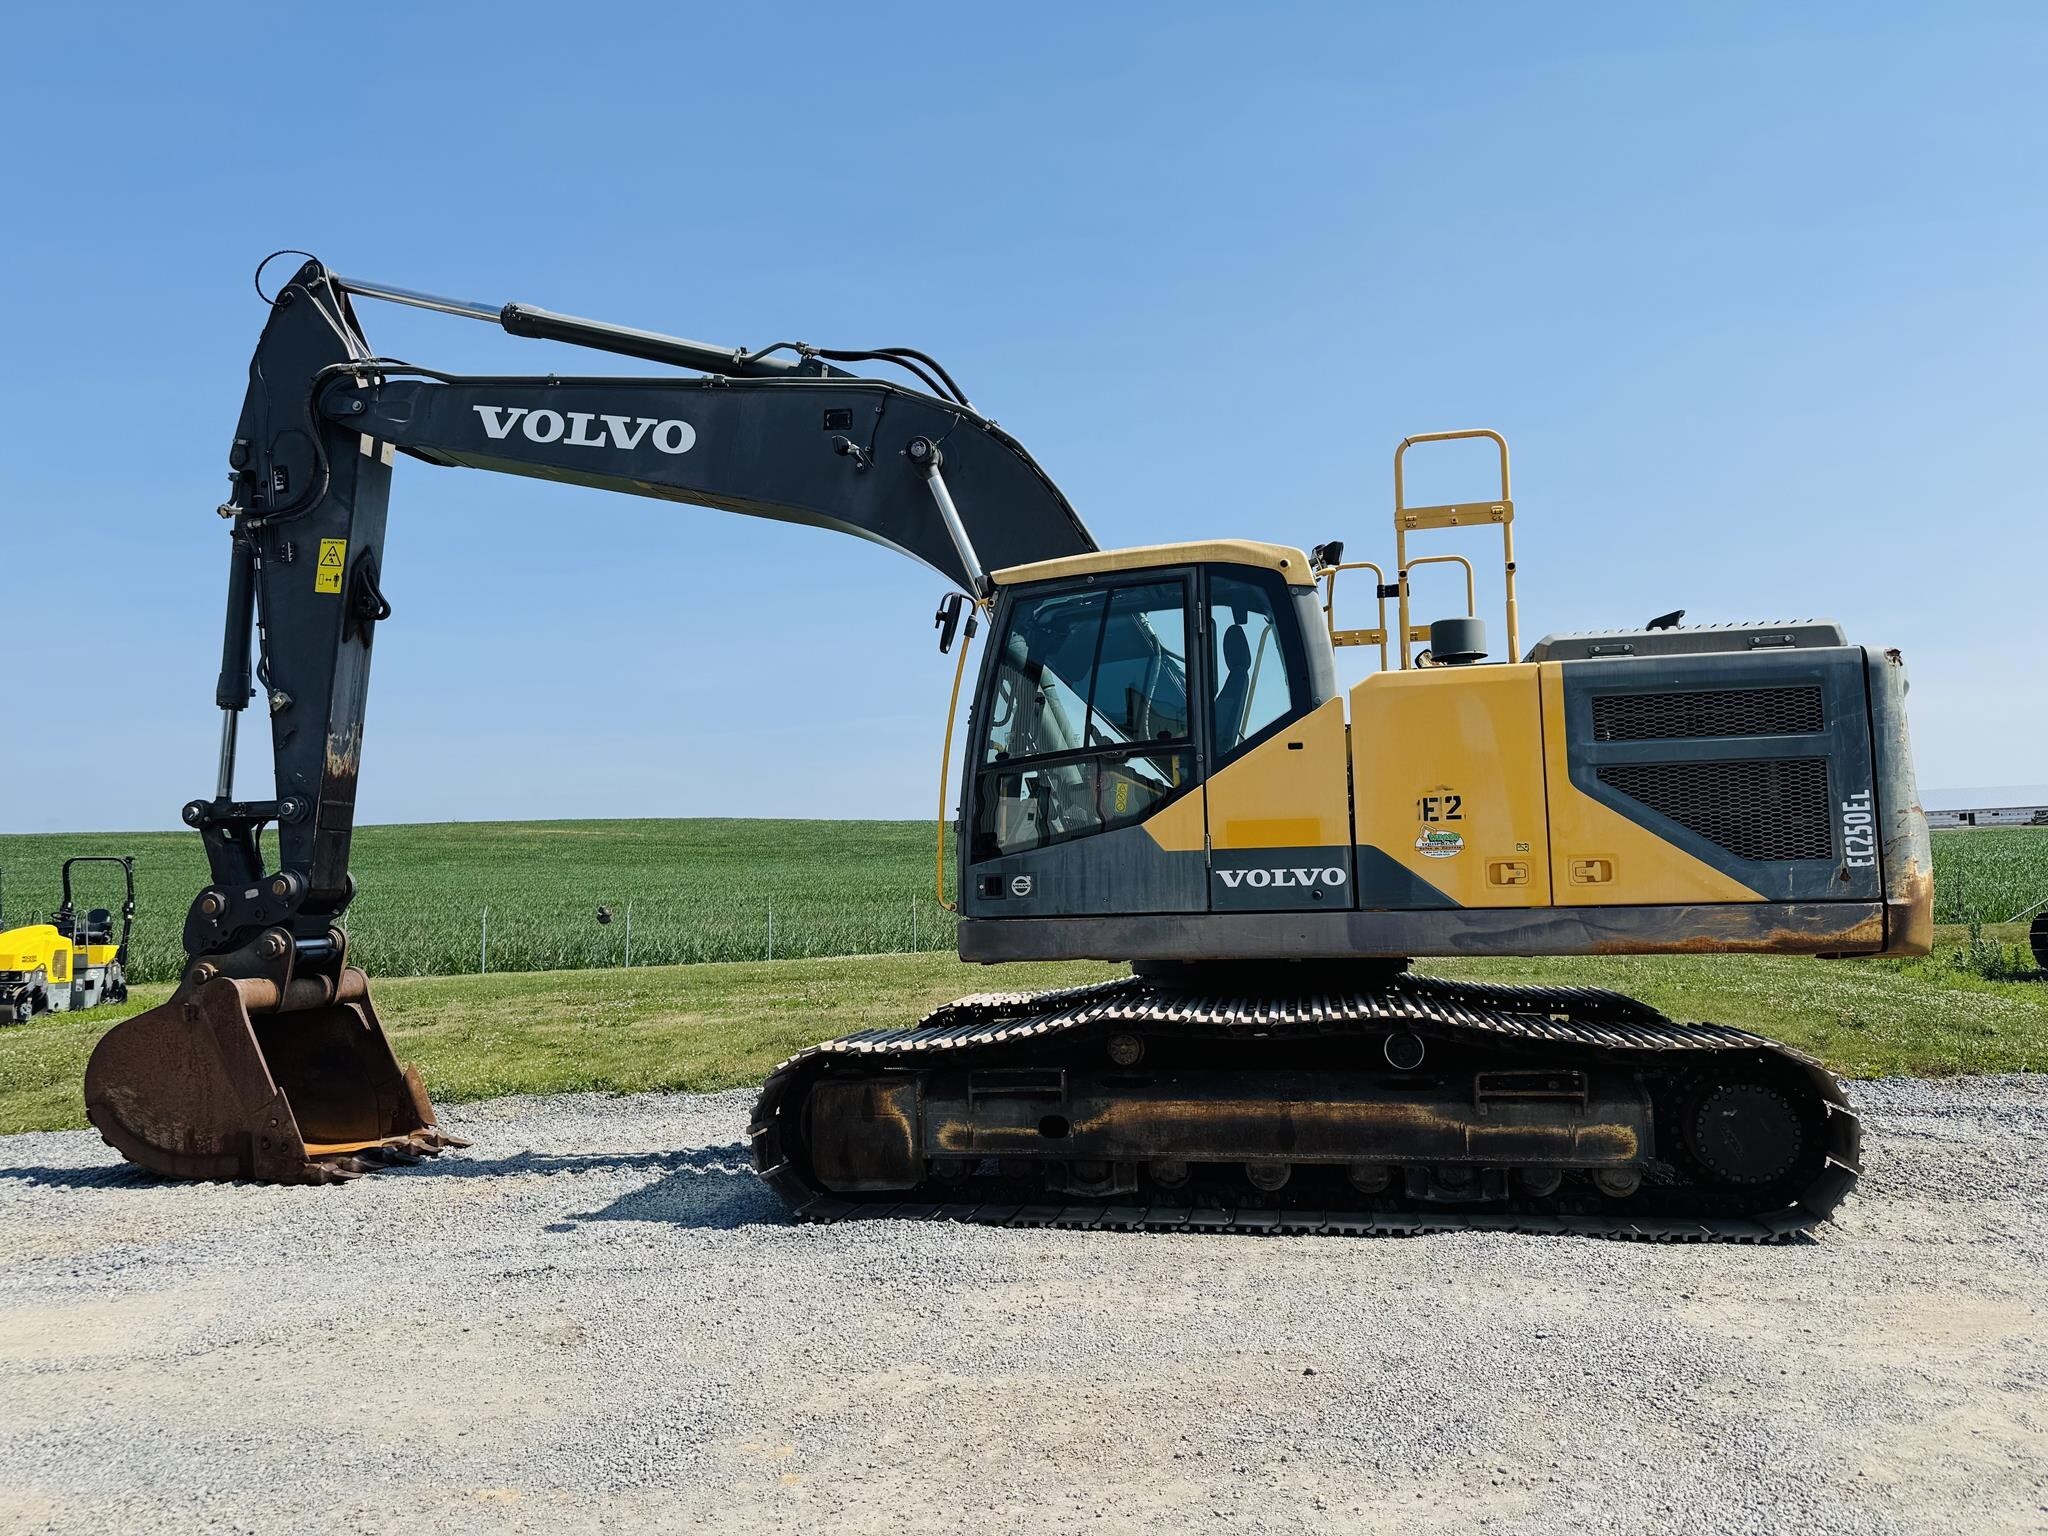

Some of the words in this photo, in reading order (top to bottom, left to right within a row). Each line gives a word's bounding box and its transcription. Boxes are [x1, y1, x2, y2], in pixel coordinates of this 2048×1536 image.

[473, 405, 697, 454] VOLVO
[1422, 795, 1462, 821] E2
[1842, 789, 1875, 867] EC250EL
[1216, 867, 1347, 887] VOLVO
